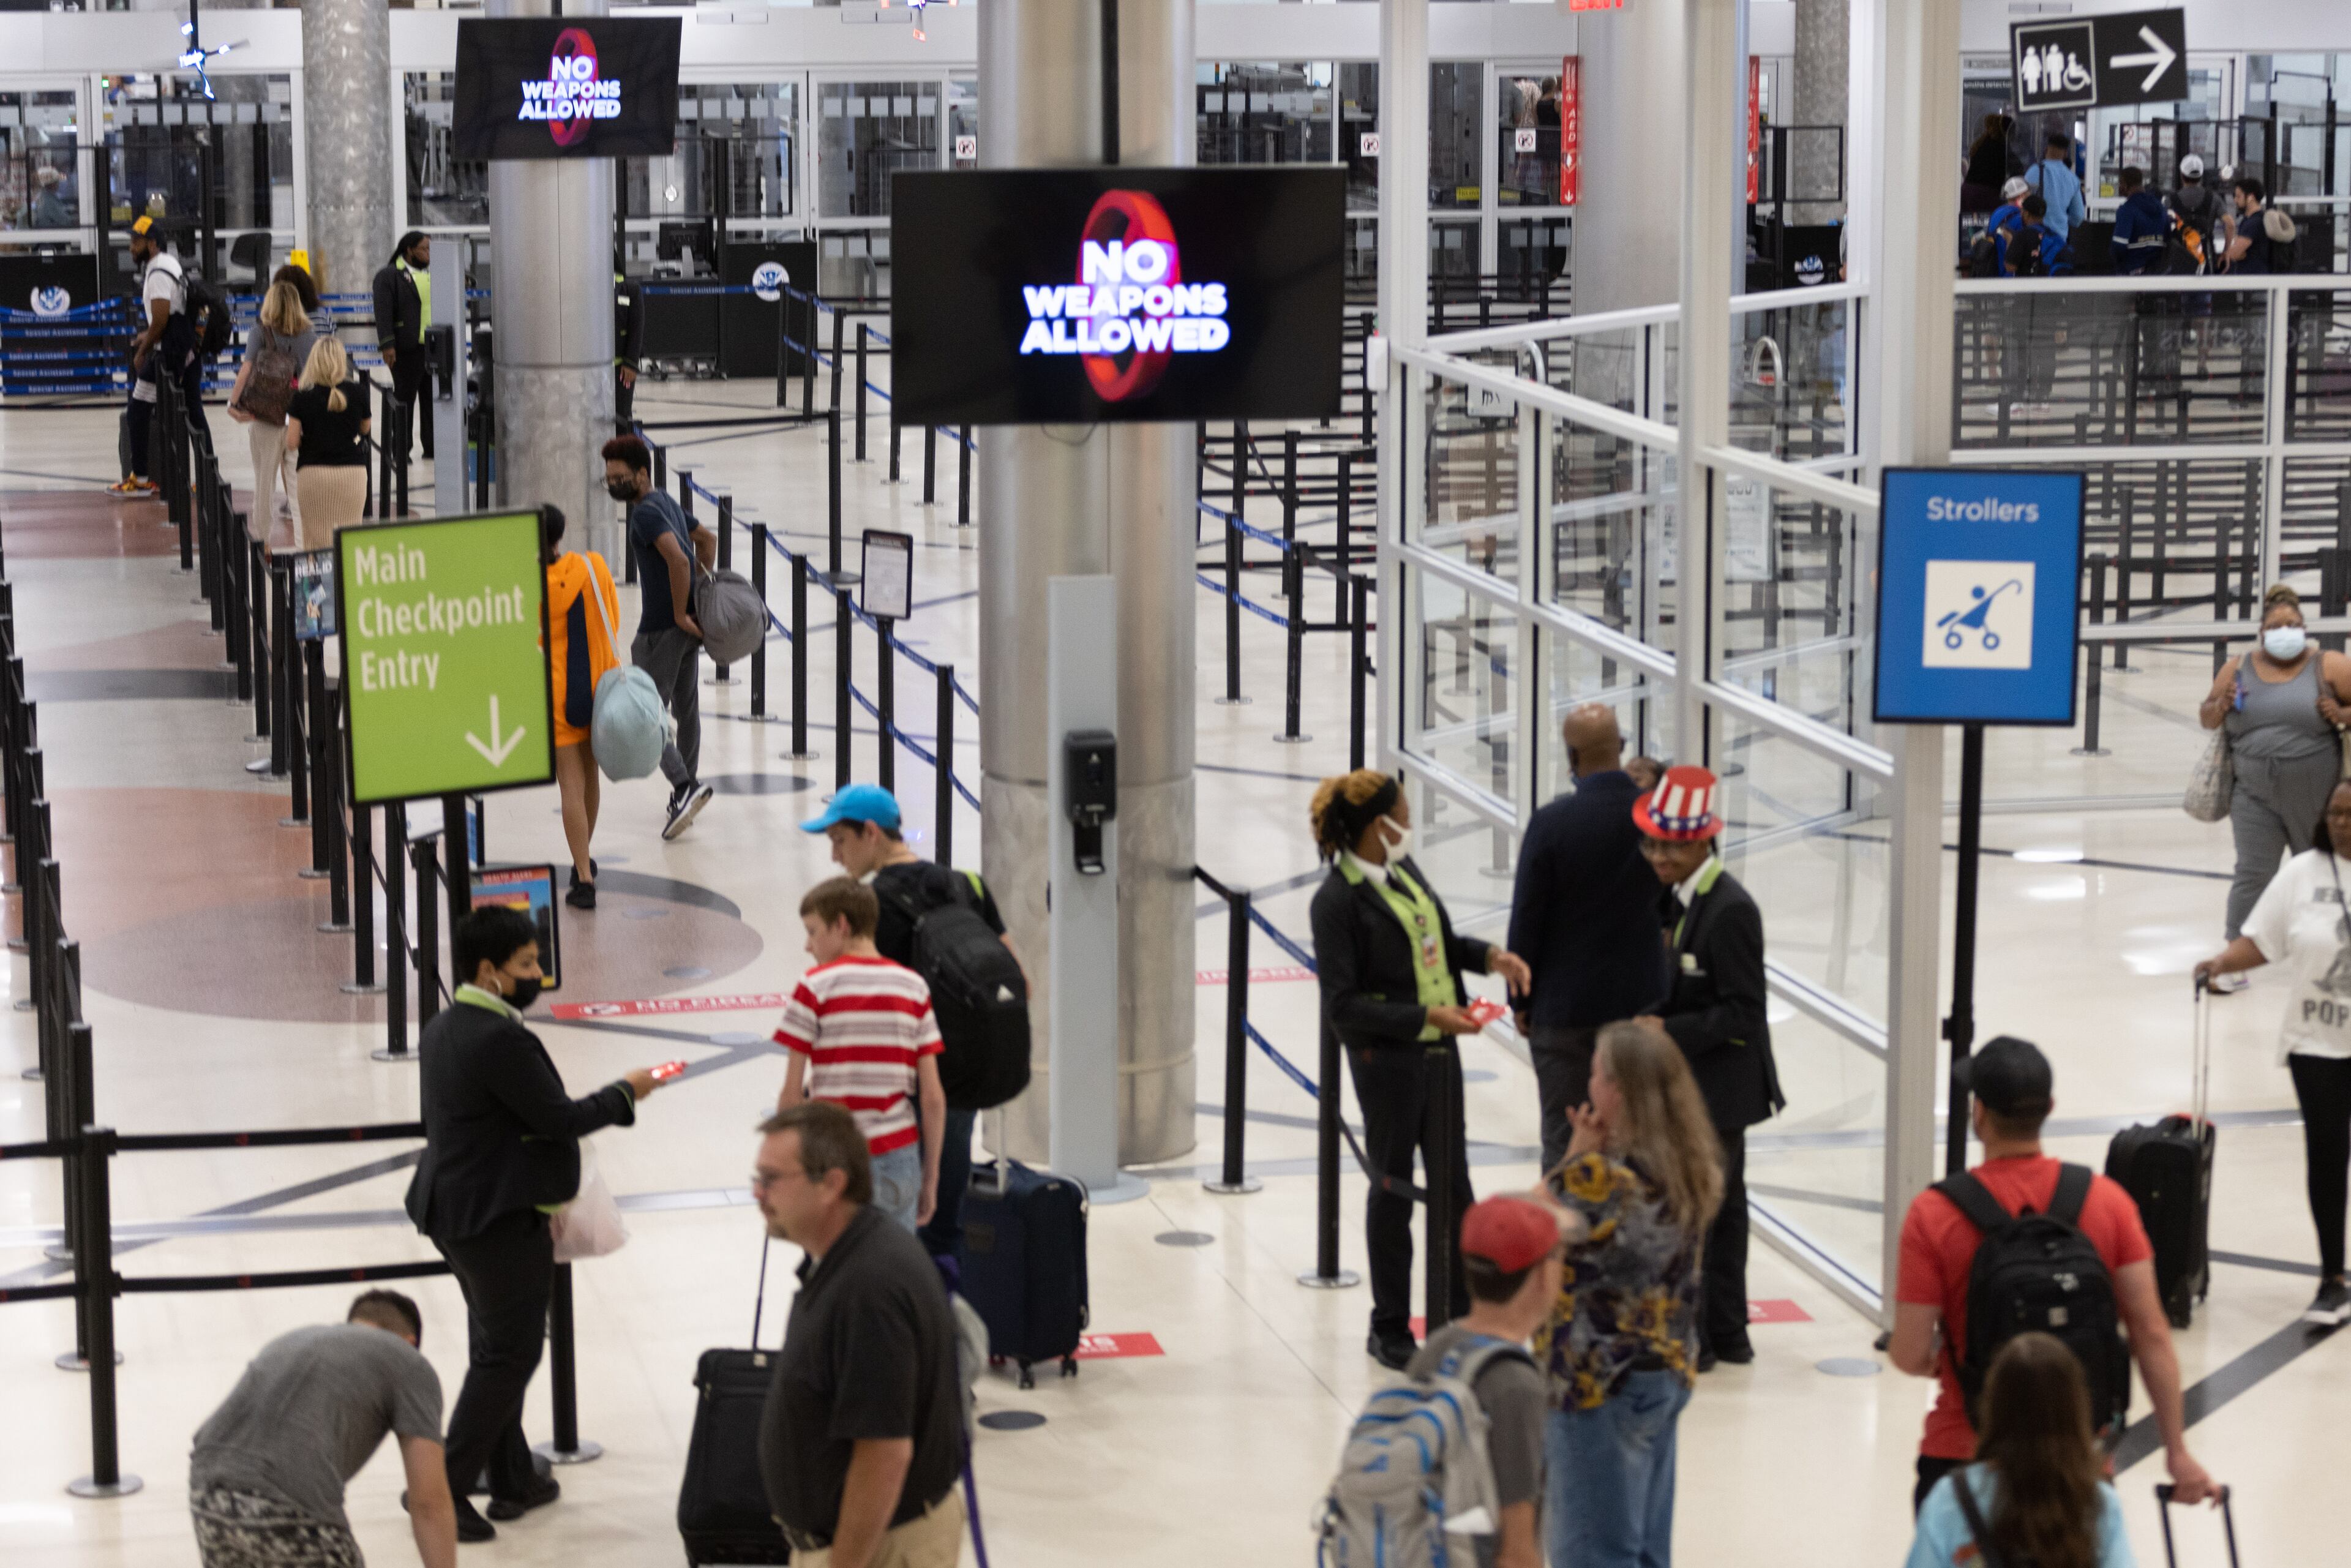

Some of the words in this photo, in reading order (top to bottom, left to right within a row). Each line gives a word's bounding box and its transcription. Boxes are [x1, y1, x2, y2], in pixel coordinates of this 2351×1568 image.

[552, 55, 594, 81] NO
[521, 80, 621, 99] WEAPONS
[518, 99, 621, 121] ALLOWED
[1082, 238, 1168, 284] NO
[1022, 282, 1228, 318] WEAPONS
[1019, 317, 1231, 354] ALLOWED
[1927, 496, 2040, 523] Strollers
[355, 543, 426, 586] Main
[358, 585, 524, 637] Checkpoint
[360, 649, 439, 691] Entry
